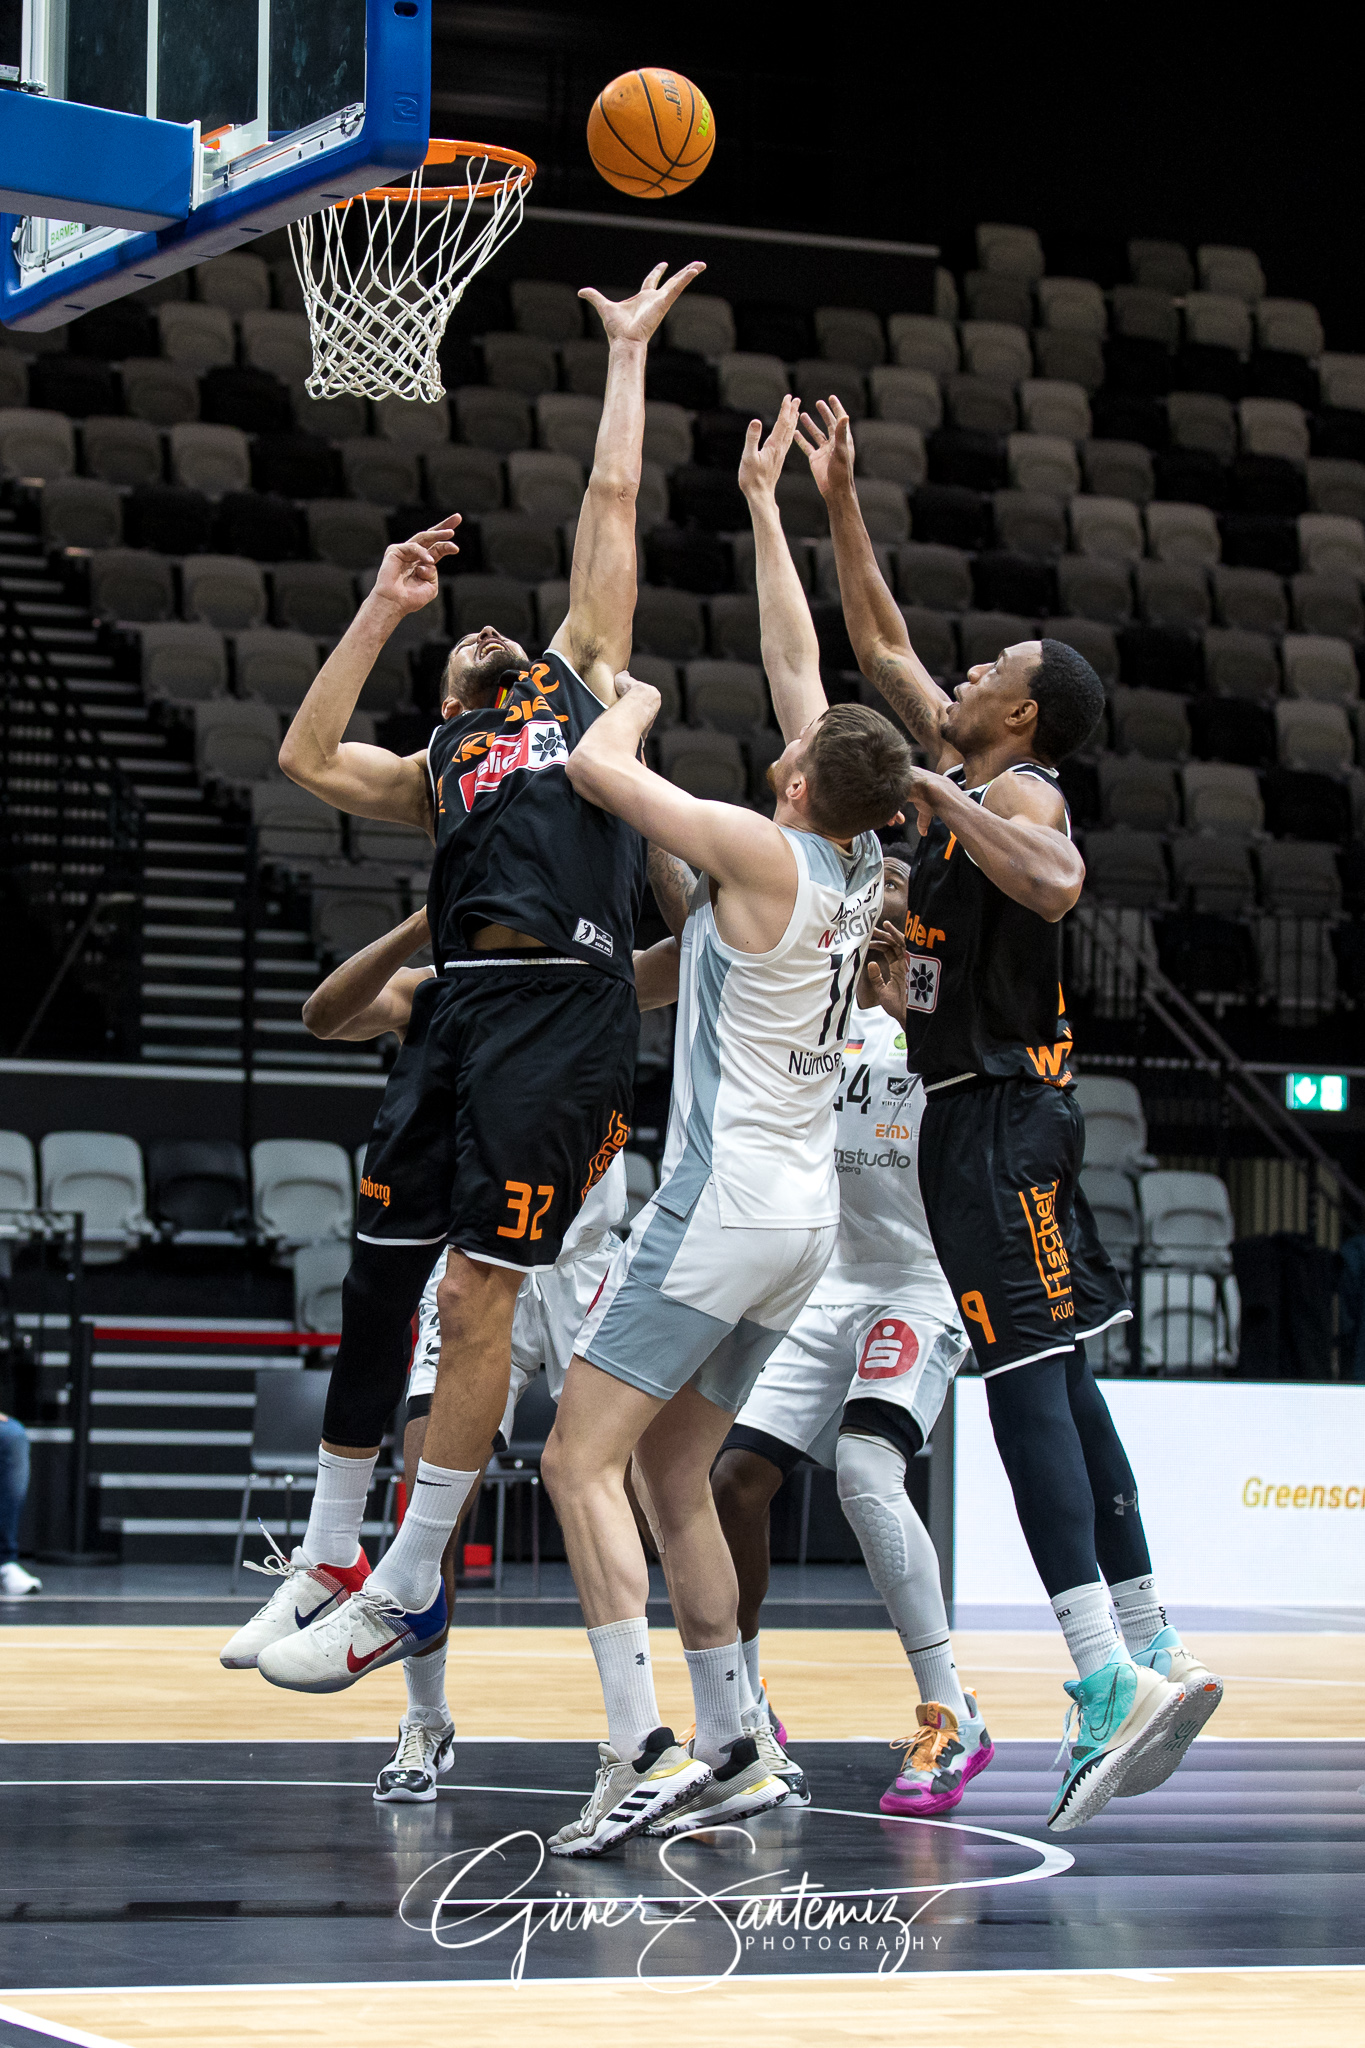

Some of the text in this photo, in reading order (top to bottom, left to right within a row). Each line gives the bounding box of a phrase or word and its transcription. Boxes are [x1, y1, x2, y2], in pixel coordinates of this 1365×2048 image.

[50, 221, 79, 246] BARMER
[818, 945, 862, 1047] 11
[497, 1180, 554, 1241] 32
[1018, 1179, 1073, 1299] Fischer
[961, 1290, 997, 1344] 9
